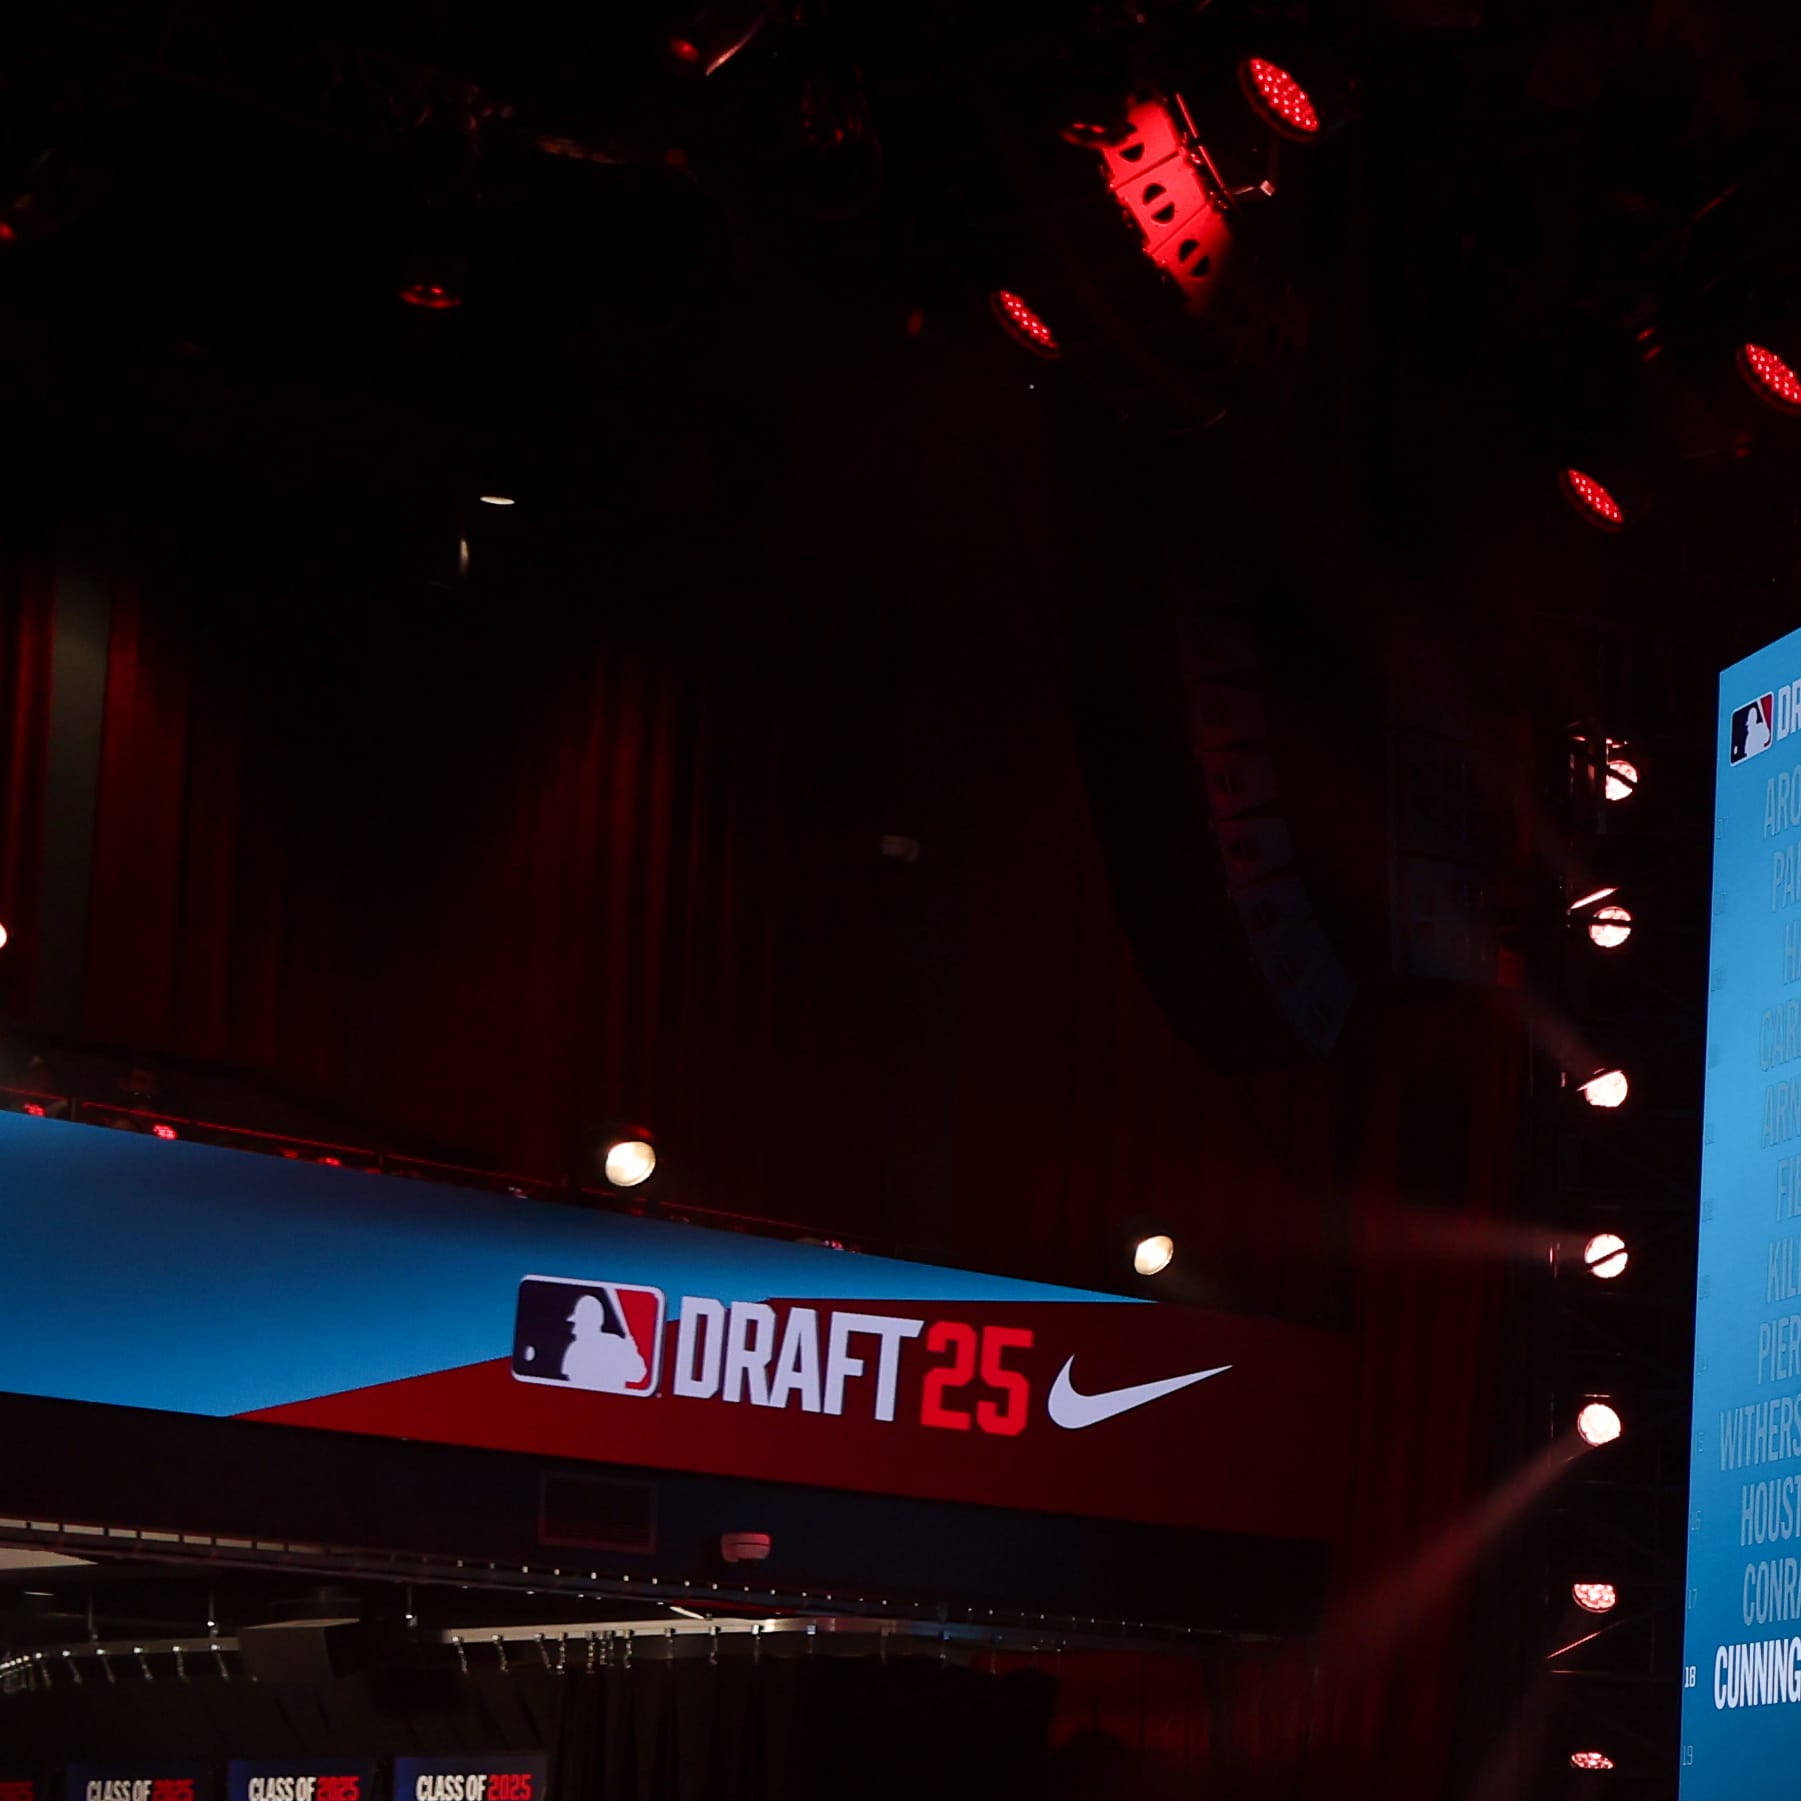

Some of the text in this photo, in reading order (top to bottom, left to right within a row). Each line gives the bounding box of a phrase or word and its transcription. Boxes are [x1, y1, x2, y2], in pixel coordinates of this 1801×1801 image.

[672, 1295, 1035, 1438] DRAFT 25
[1684, 1665, 1696, 1688] 18
[416, 1774, 533, 1801] CLASS OF 2025
